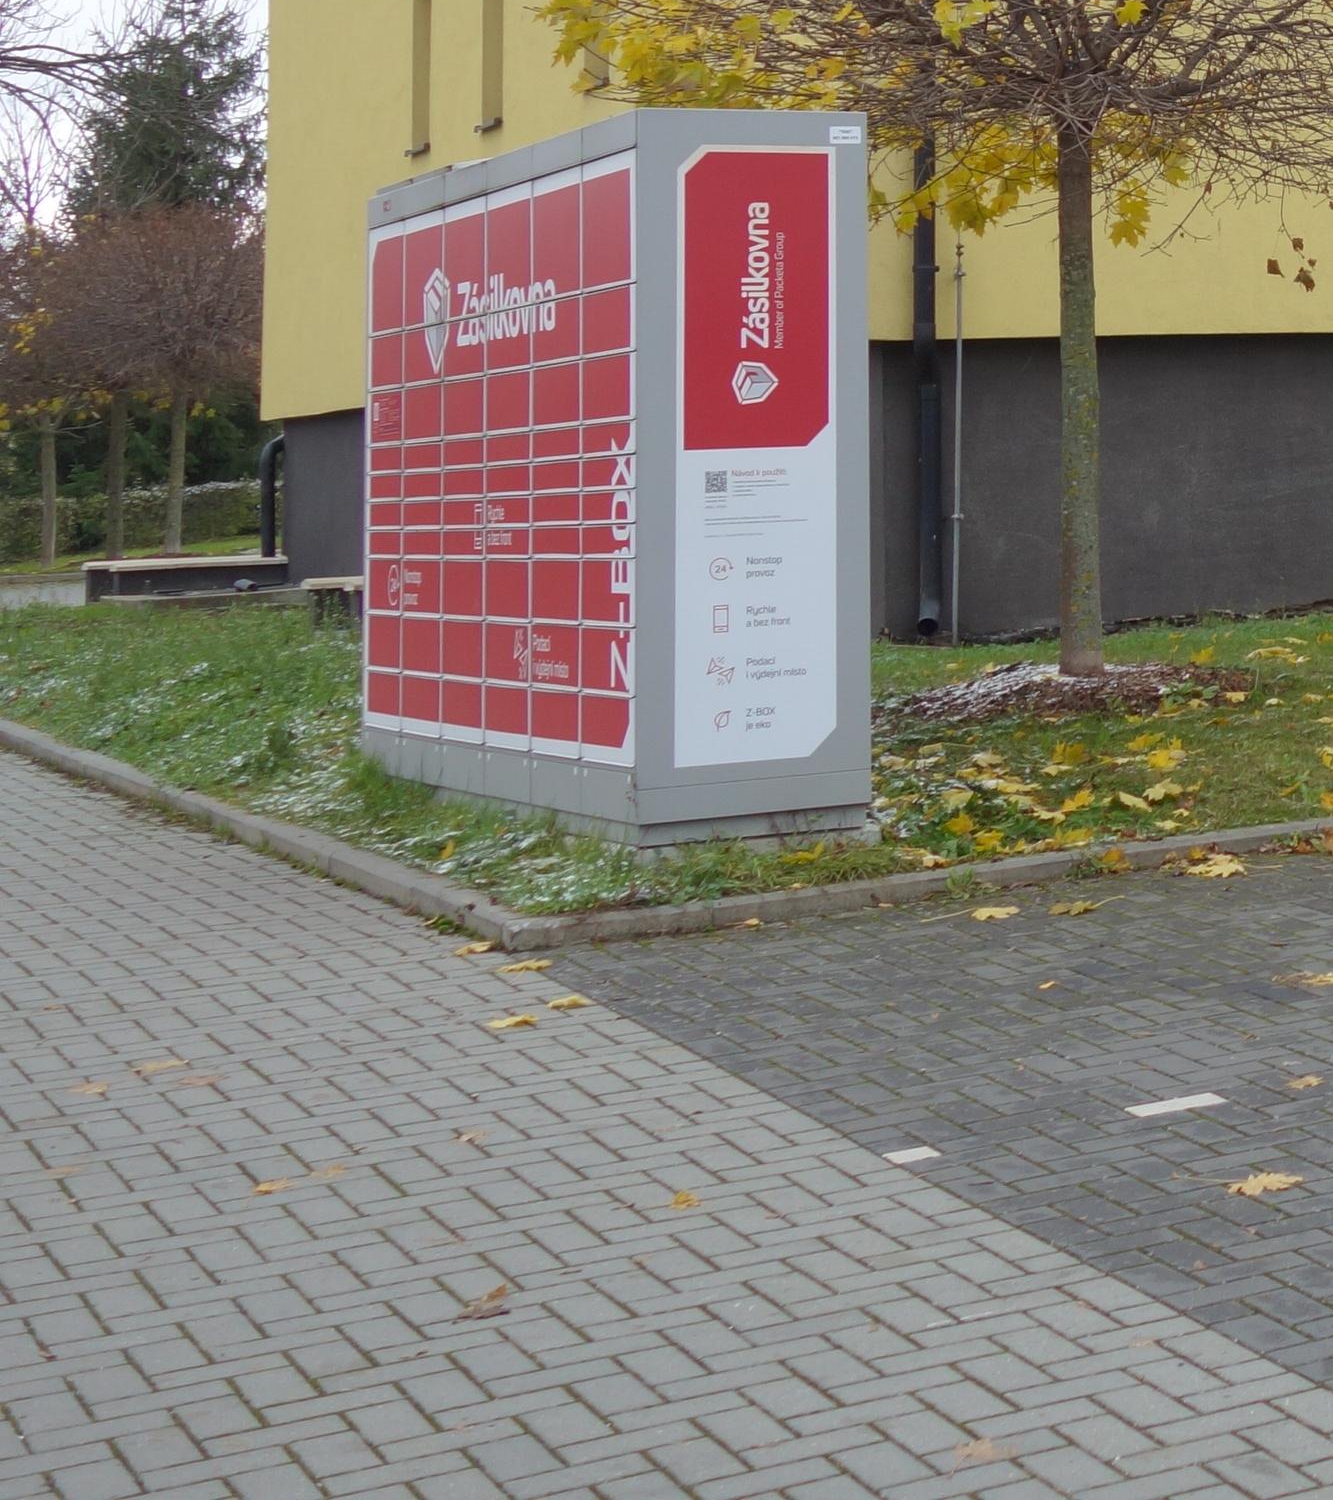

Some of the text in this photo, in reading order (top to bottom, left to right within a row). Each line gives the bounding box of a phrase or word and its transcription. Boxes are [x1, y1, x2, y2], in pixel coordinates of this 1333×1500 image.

[774, 231, 786, 260] Group
[740, 201, 770, 349] Zásilkovna
[774, 260, 784, 299] Packeta
[456, 272, 556, 348] Zásilkovna
[774, 309, 784, 349] Member
[610, 436, 631, 693] Z-BOX
[714, 564, 727, 575] 24
[746, 556, 783, 566] Nonstop
[746, 569, 776, 580] provoz
[746, 604, 777, 617] Rychle
[753, 617, 769, 628] bez
[746, 706, 776, 717] Z-BOX
